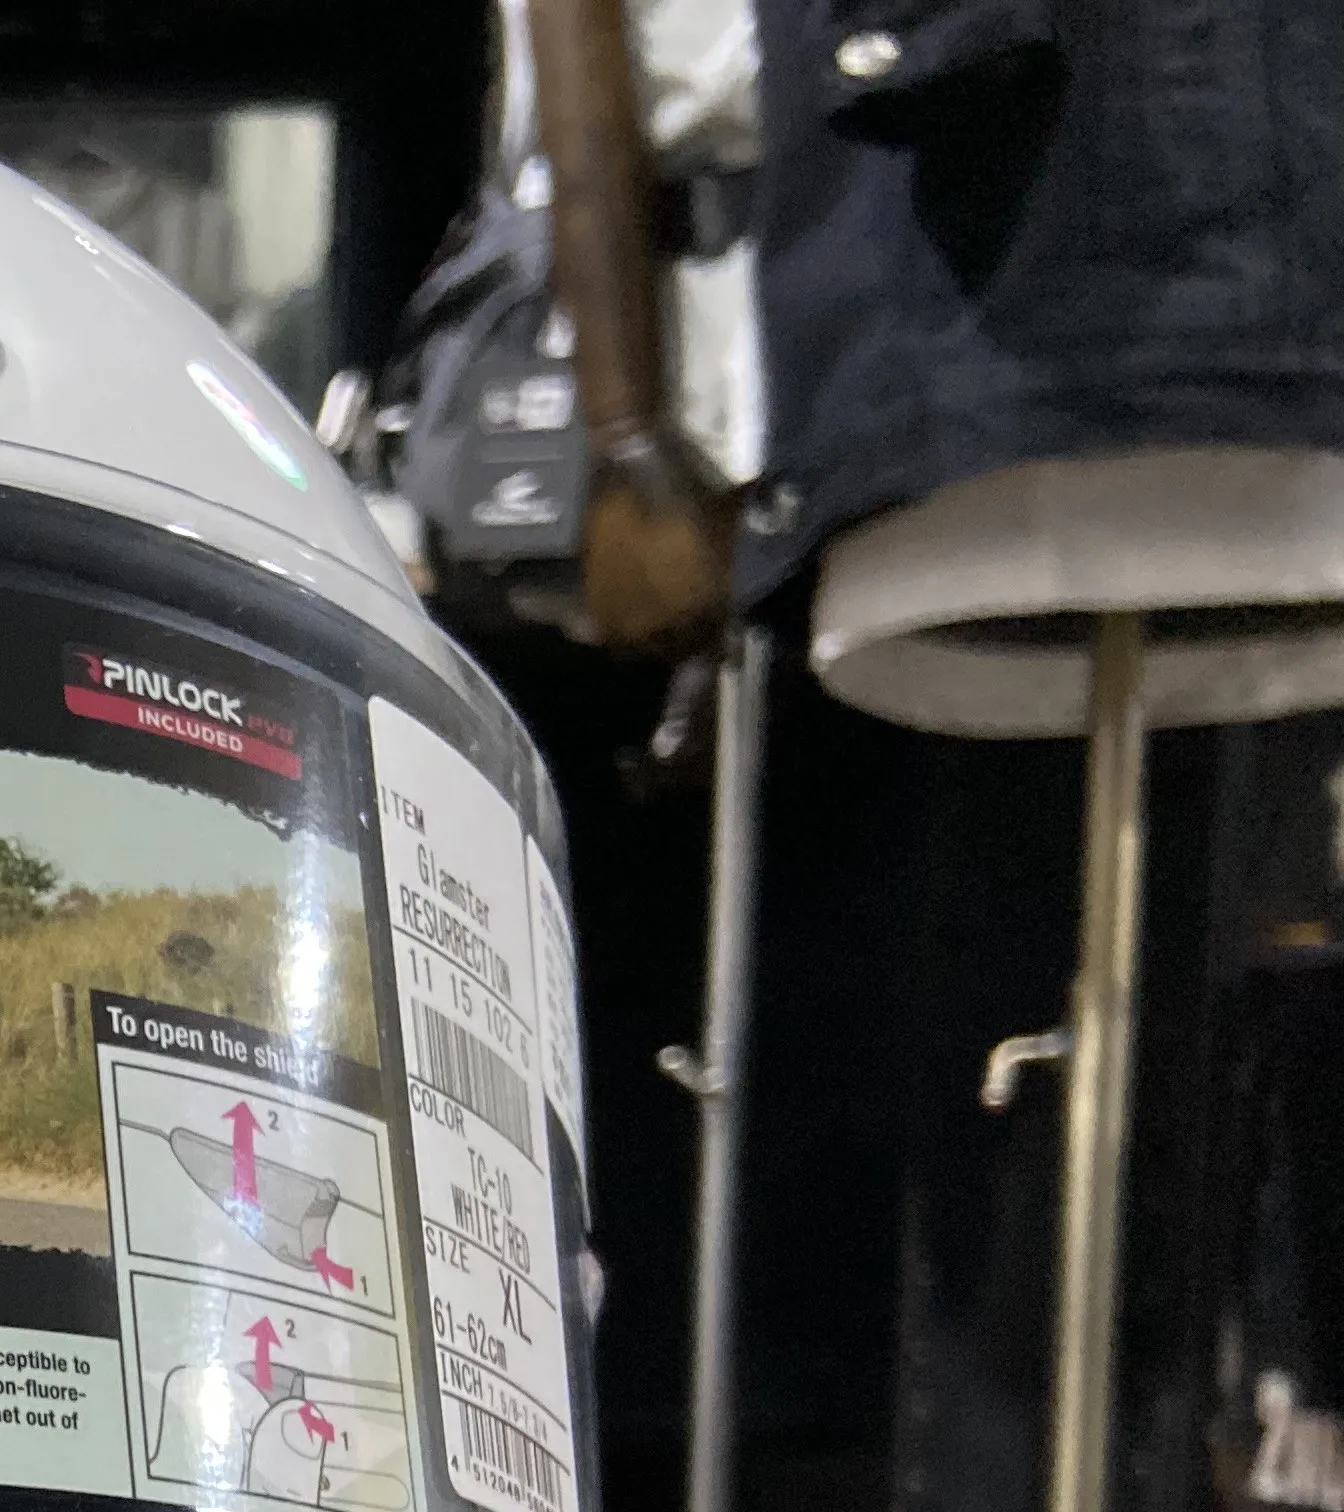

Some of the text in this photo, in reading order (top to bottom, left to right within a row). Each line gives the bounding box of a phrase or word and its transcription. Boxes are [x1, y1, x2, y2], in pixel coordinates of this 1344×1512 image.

[102, 659, 243, 726] PINLOCK
[138, 706, 243, 752] INCLUDED
[381, 785, 426, 836] ITEM
[417, 843, 491, 931] Glamster
[408, 948, 432, 992] 11
[450, 972, 473, 1017] 15
[485, 999, 513, 1055] 102
[106, 1006, 138, 1038] To
[144, 1019, 204, 1052] open
[211, 1029, 249, 1064] the
[268, 1111, 280, 1131] 2
[409, 1083, 466, 1137] COLOR
[467, 1147, 512, 1215] TC-10
[425, 1225, 471, 1274] SIZE
[451, 1183, 531, 1275] WHITE/RED
[360, 1275, 370, 1296] 1
[498, 1267, 533, 1346] XL
[285, 1319, 296, 1339] 2
[433, 1296, 508, 1372] 61-62cm
[73, 1357, 91, 1376] to
[438, 1352, 484, 1400] INCH
[26, 1409, 56, 1427] out
[61, 1411, 79, 1430] of
[341, 1431, 349, 1452] 1
